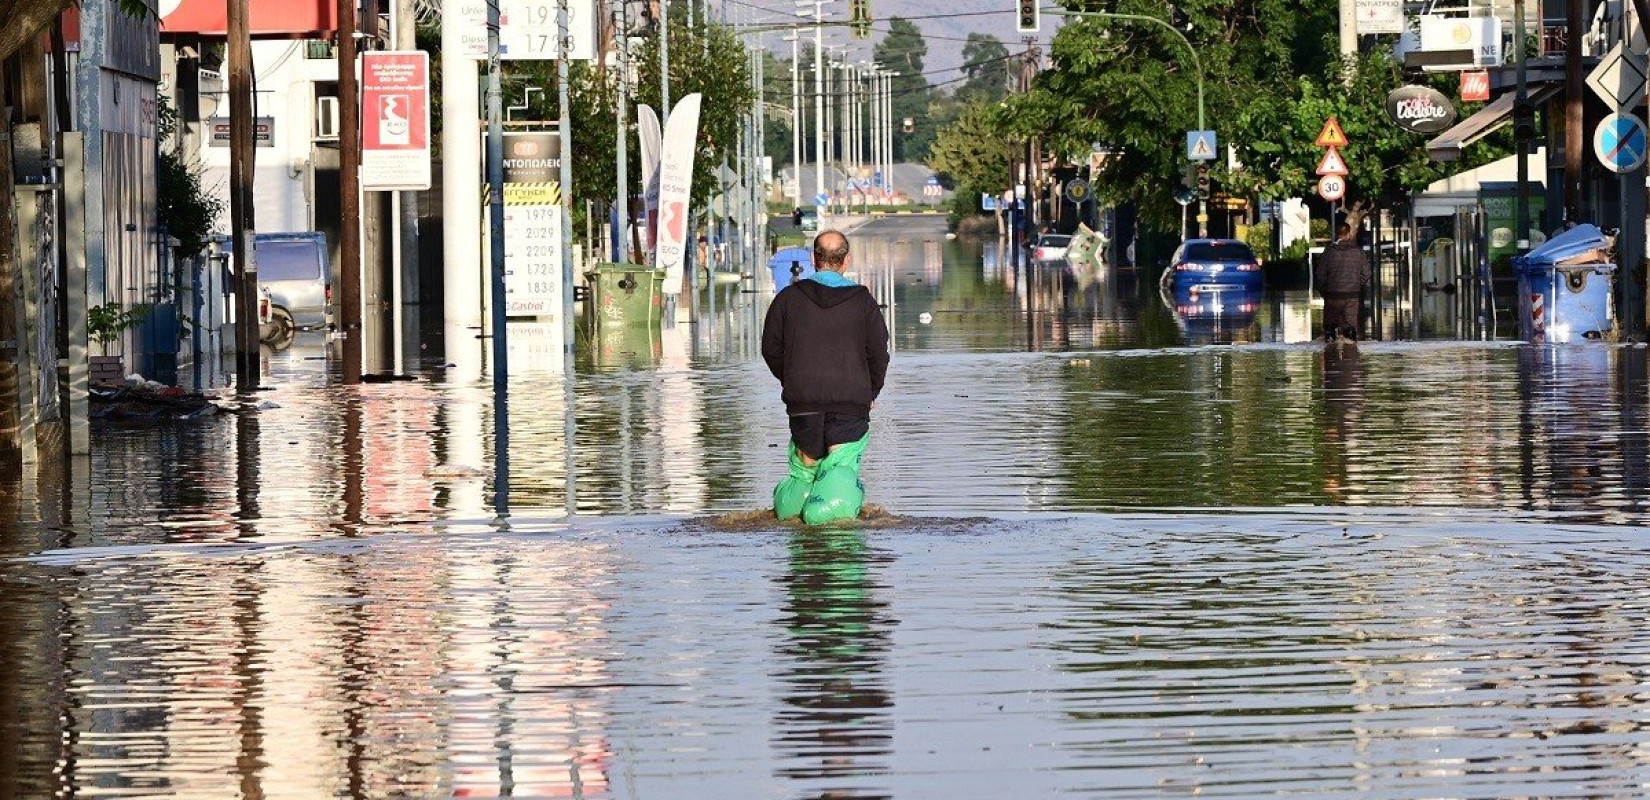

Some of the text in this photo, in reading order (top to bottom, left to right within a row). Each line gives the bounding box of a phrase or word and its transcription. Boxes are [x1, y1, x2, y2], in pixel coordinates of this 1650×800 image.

[1464, 76, 1488, 96] illy
[1325, 182, 1339, 192] 30
[526, 209, 555, 220] 1979
[526, 228, 555, 239] 2029
[526, 246, 555, 257] 2209
